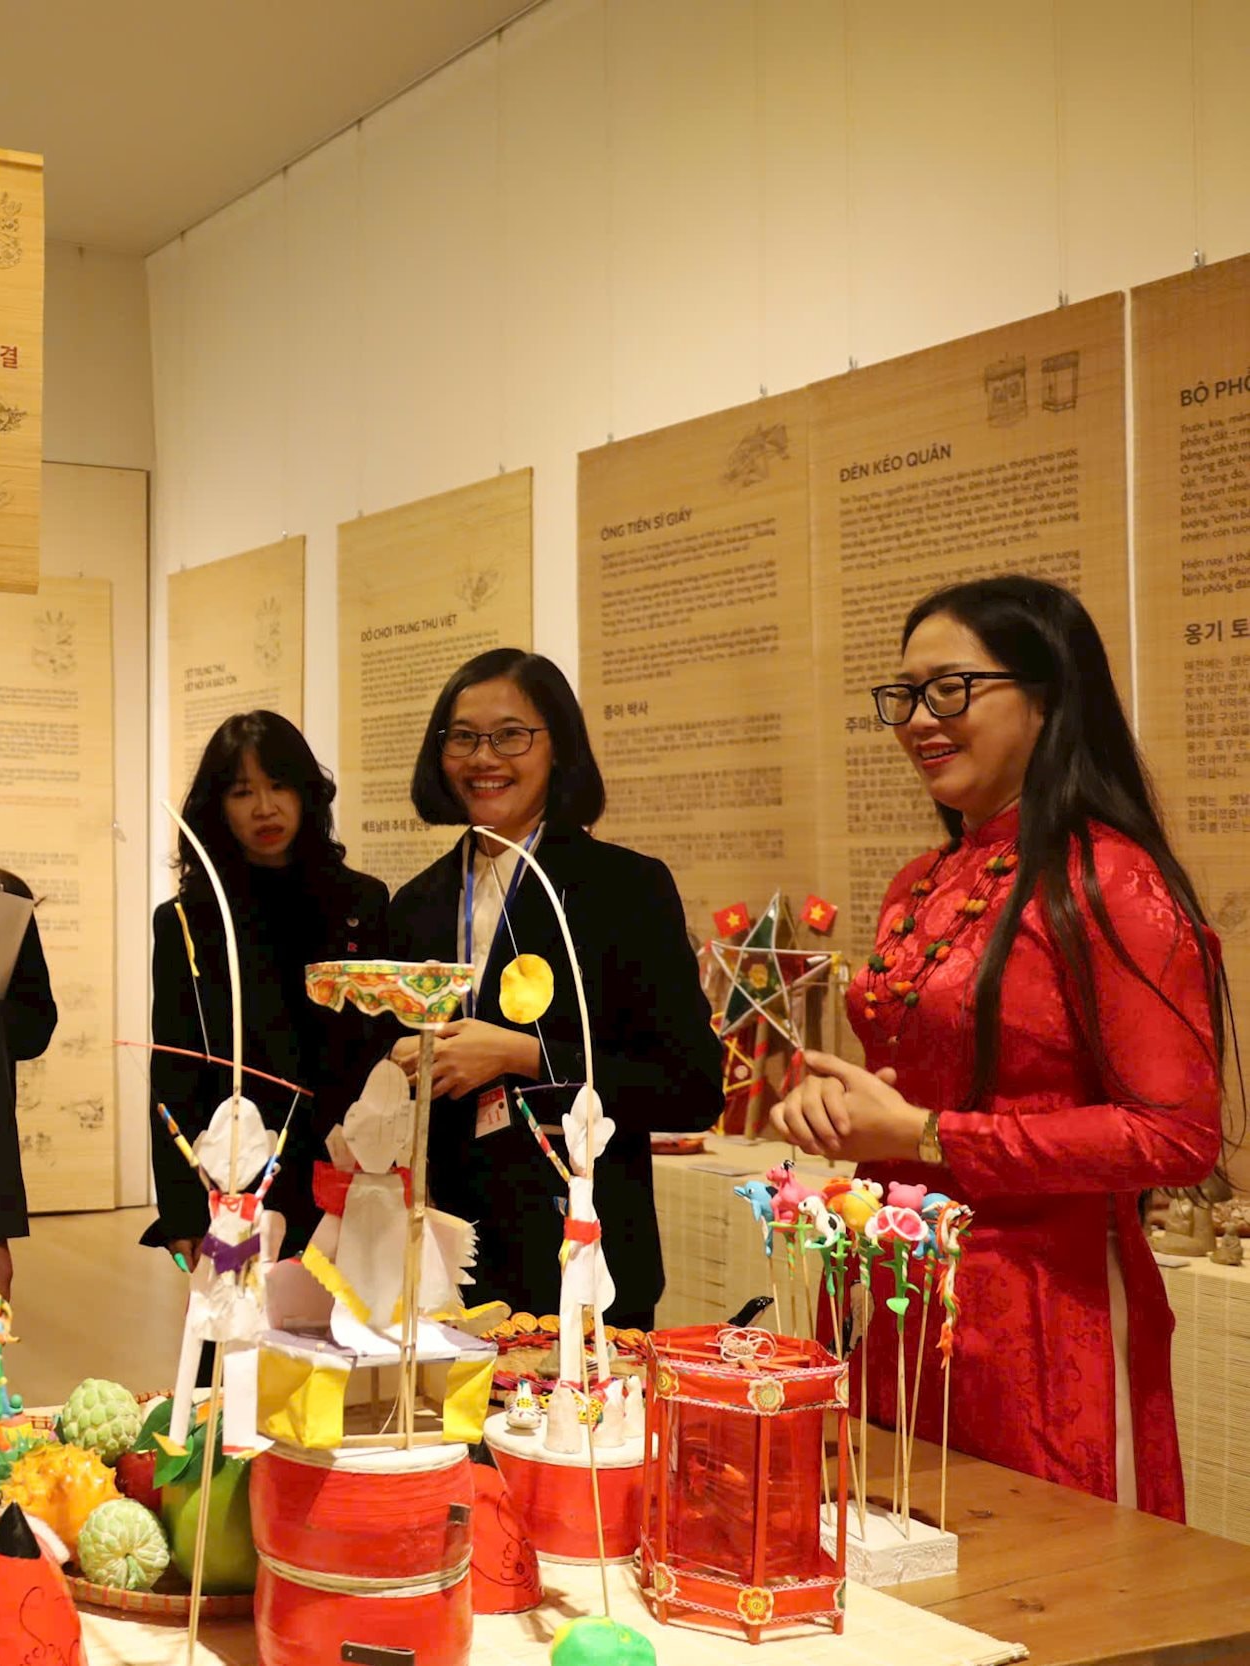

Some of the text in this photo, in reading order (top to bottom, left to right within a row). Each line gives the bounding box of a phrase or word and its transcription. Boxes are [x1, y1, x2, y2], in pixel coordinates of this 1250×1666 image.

[1180, 380, 1209, 407] BỘ
[839, 442, 951, 482] ĐÈN KÉO QUÂN
[394, 621, 421, 636] TRUNG
[421, 617, 439, 629] THU
[1184, 619, 1222, 645] 옹기
[627, 699, 648, 717] 박사
